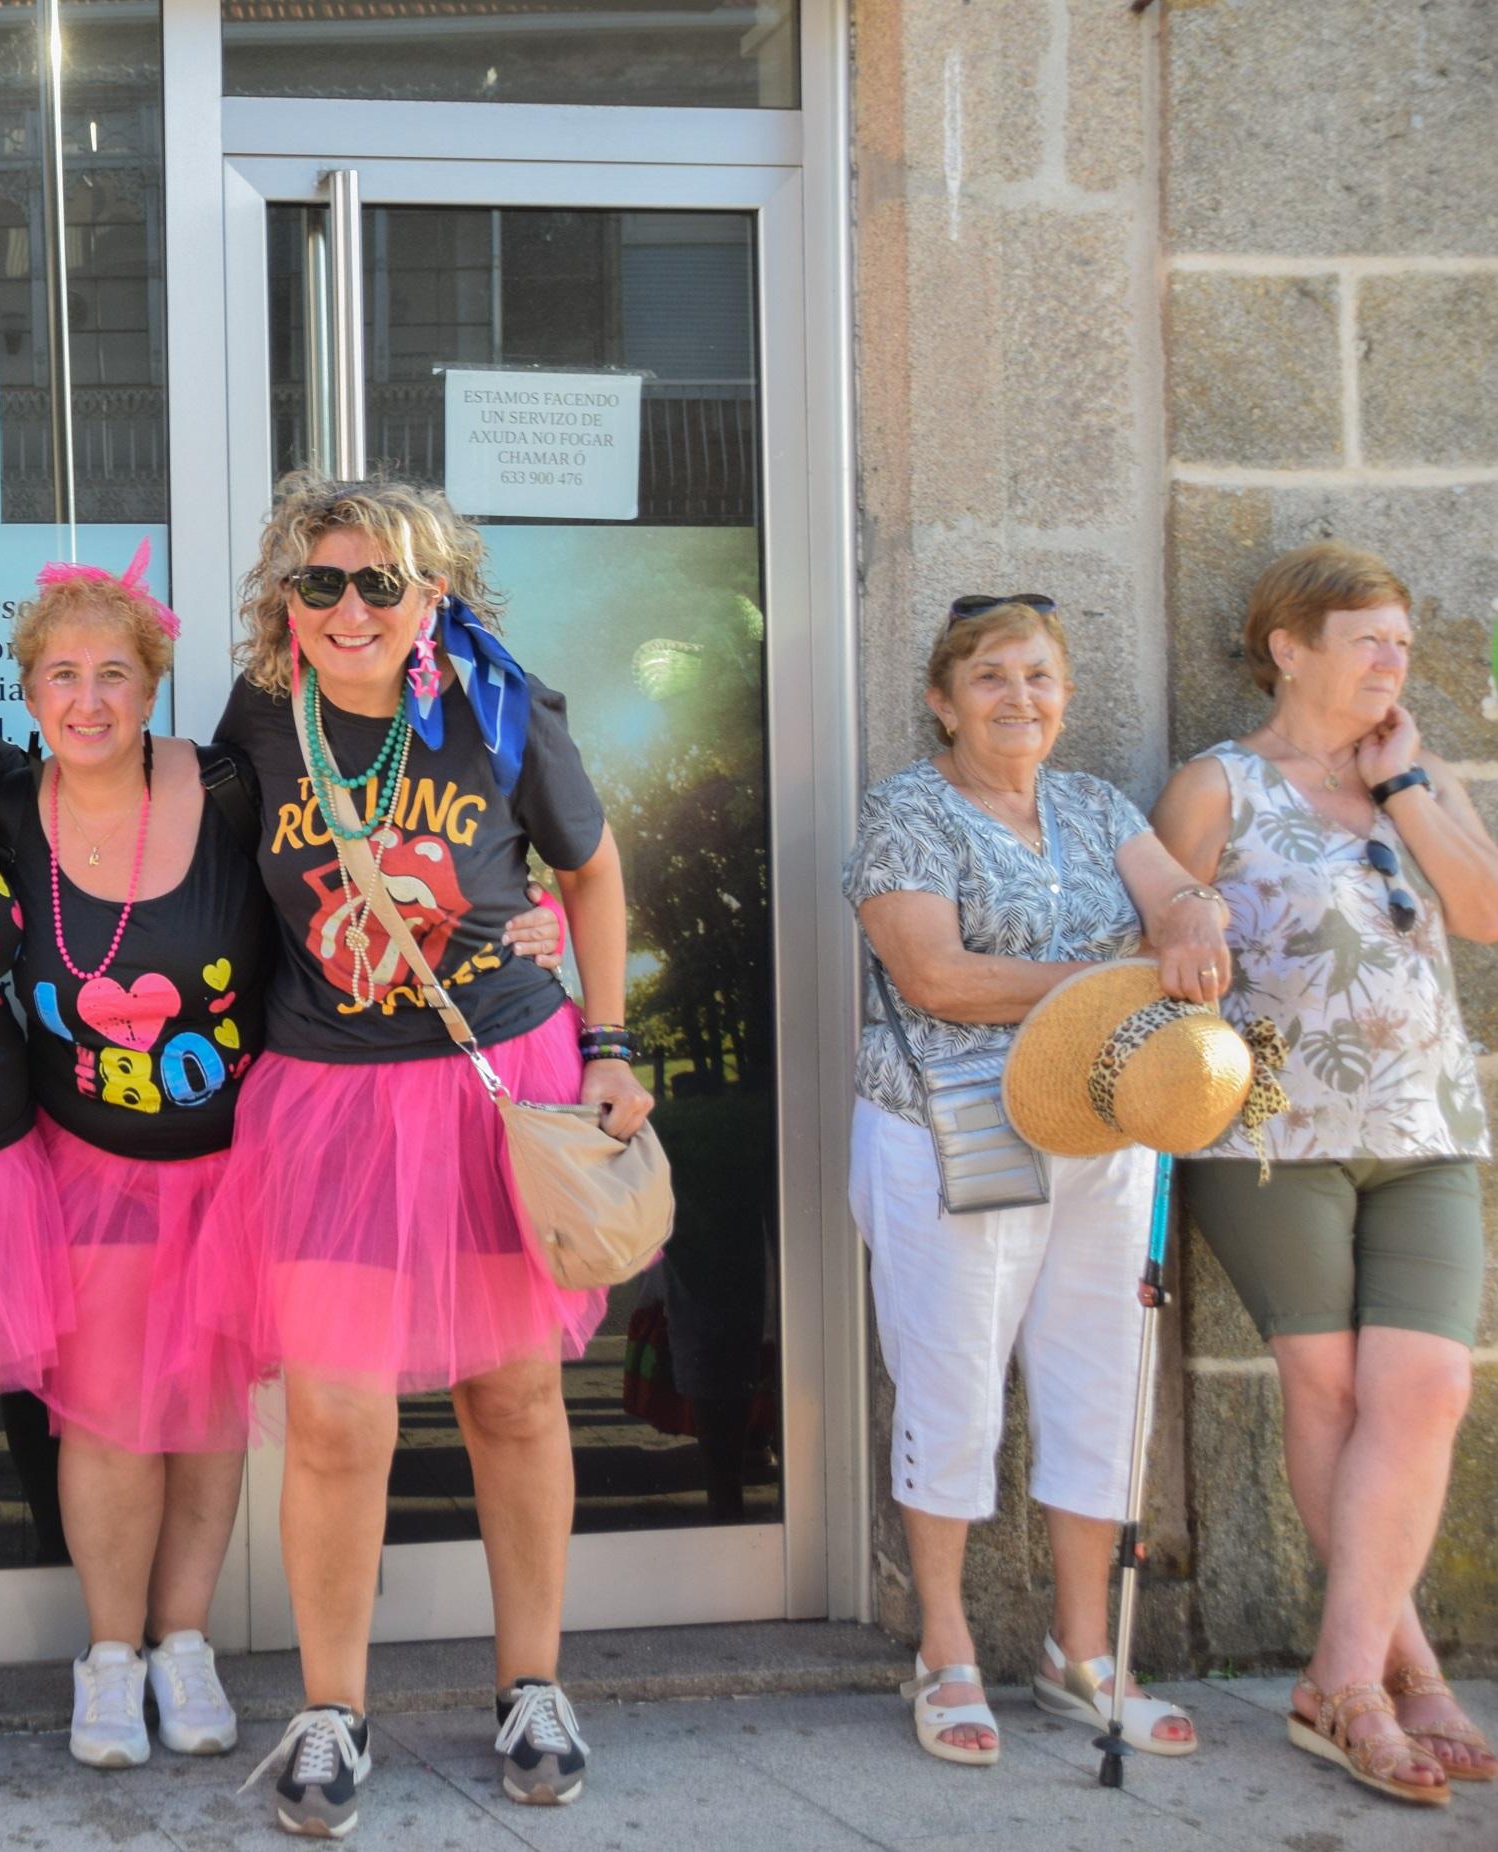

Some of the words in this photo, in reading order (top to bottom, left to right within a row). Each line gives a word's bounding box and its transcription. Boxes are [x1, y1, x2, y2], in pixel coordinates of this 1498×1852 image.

[463, 390, 539, 406] ESTAMOS
[543, 392, 619, 408] FACENDO
[481, 410, 504, 424] UN
[509, 410, 578, 426] SERVIZO
[581, 413, 603, 427] DE
[469, 430, 529, 445] AXUDA
[532, 432, 556, 446] NO
[560, 433, 615, 448] FOGAR
[498, 450, 569, 466] CHAMAR
[500, 471, 526, 485] 633
[529, 471, 553, 486] 900
[558, 472, 583, 487] 476
